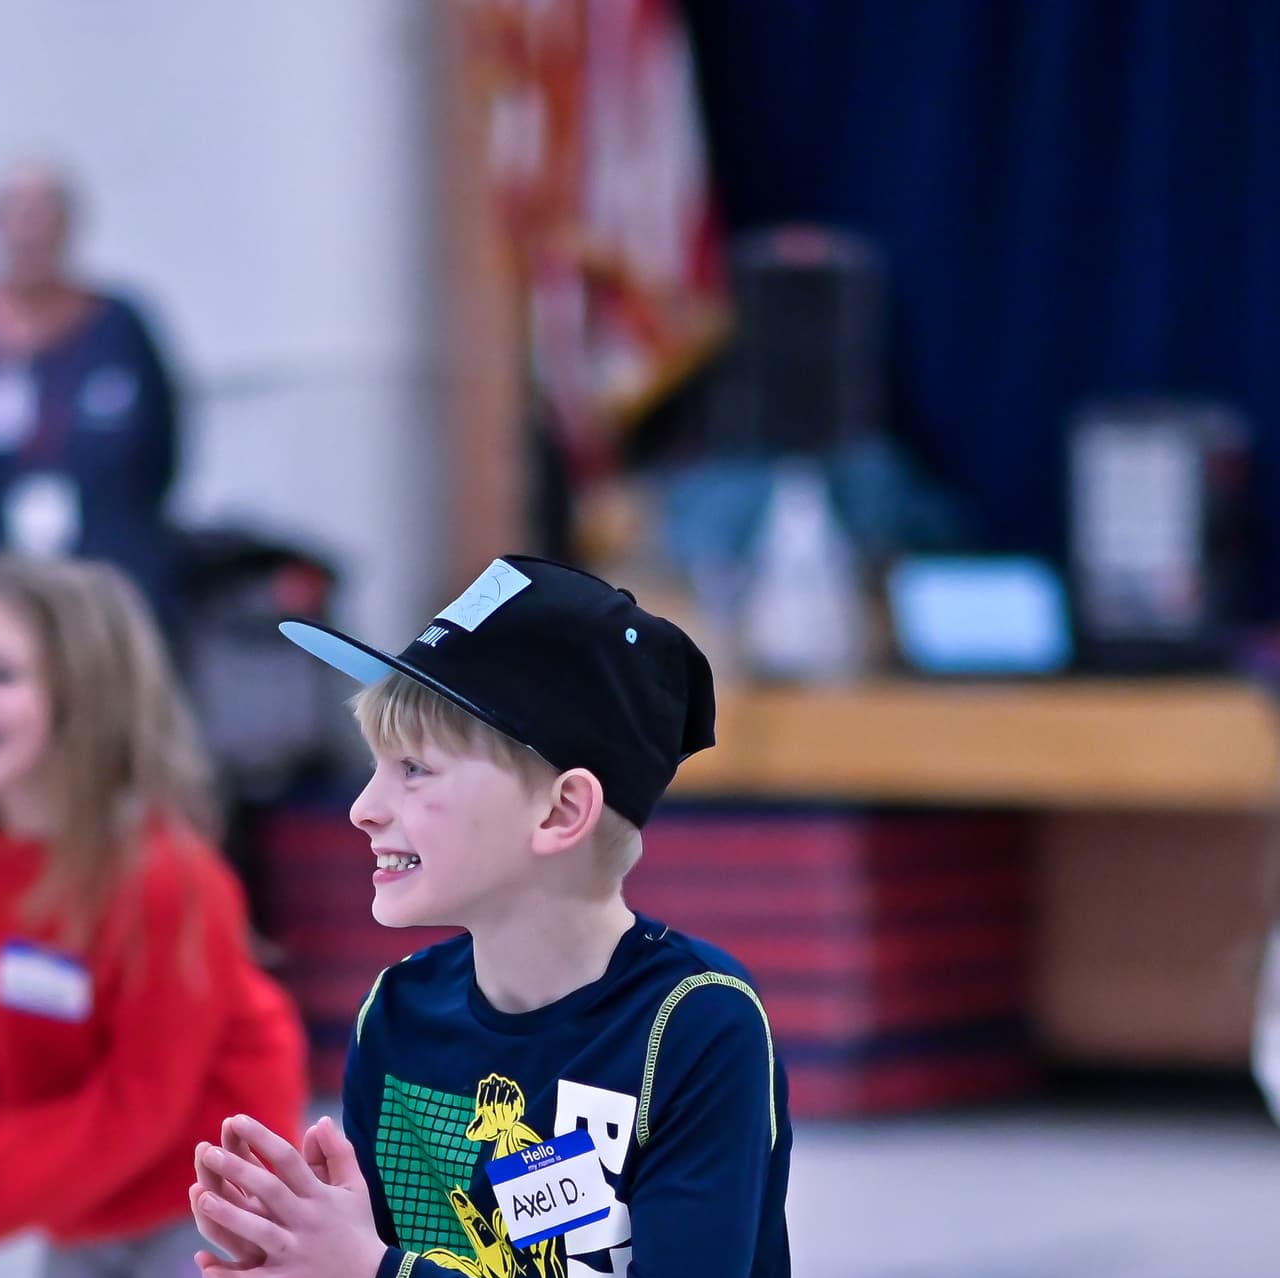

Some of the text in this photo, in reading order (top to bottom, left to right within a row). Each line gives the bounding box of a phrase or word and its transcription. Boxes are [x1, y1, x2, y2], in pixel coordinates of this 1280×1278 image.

[520, 1144, 555, 1165] Hello
[512, 1177, 586, 1221] Axel D.
